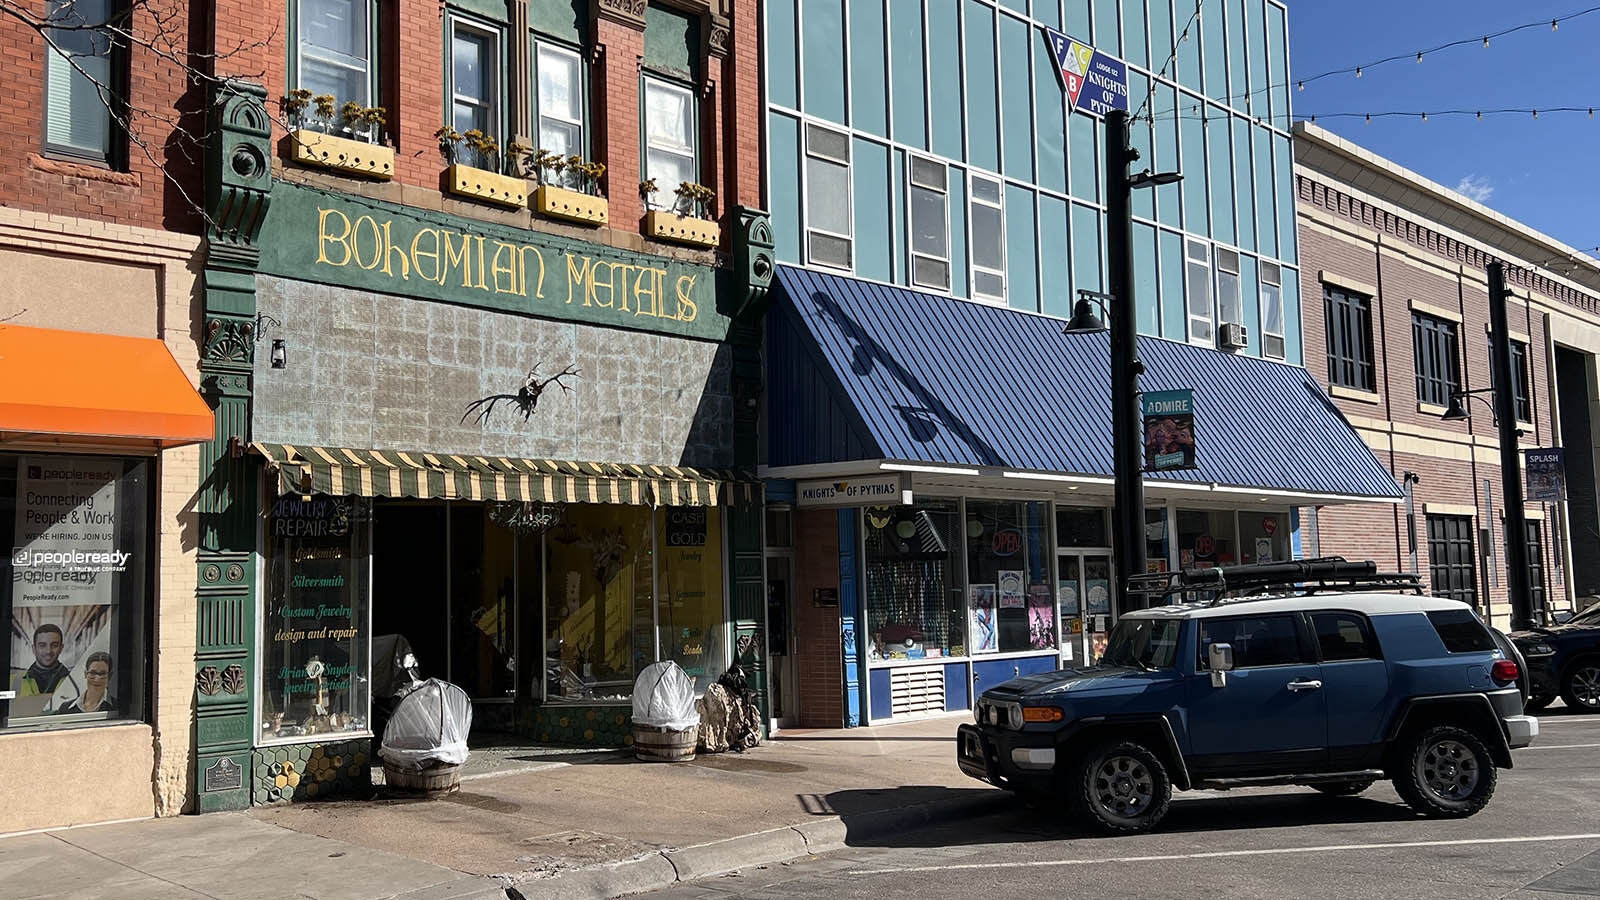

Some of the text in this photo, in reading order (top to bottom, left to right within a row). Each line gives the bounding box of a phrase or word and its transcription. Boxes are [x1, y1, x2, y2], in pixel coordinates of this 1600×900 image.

[1056, 37, 1087, 65] F C
[1068, 74, 1077, 92] B
[1088, 70, 1127, 97] KNIGHTS
[1102, 90, 1114, 104] OF
[565, 252, 698, 322] METALS
[1147, 400, 1189, 413] ADMIRE
[1529, 454, 1559, 463] SPLASH
[802, 483, 895, 499] KNIGHTS OF PYTHIAS
[26, 491, 94, 509] Connecting
[26, 509, 115, 527] People & Work
[671, 512, 706, 524] CASH
[275, 518, 328, 537] REPAIR
[25, 532, 50, 541] WE'RE
[82, 532, 100, 541] JOIN
[670, 532, 707, 545] GOLD
[991, 532, 1021, 552] OPEN
[34, 549, 128, 567] peopleready
[291, 575, 345, 588] Silversmith
[22, 593, 70, 601] PeopleReady.com
[281, 603, 353, 619] Custom Jewelry
[274, 625, 358, 643] design and repair
